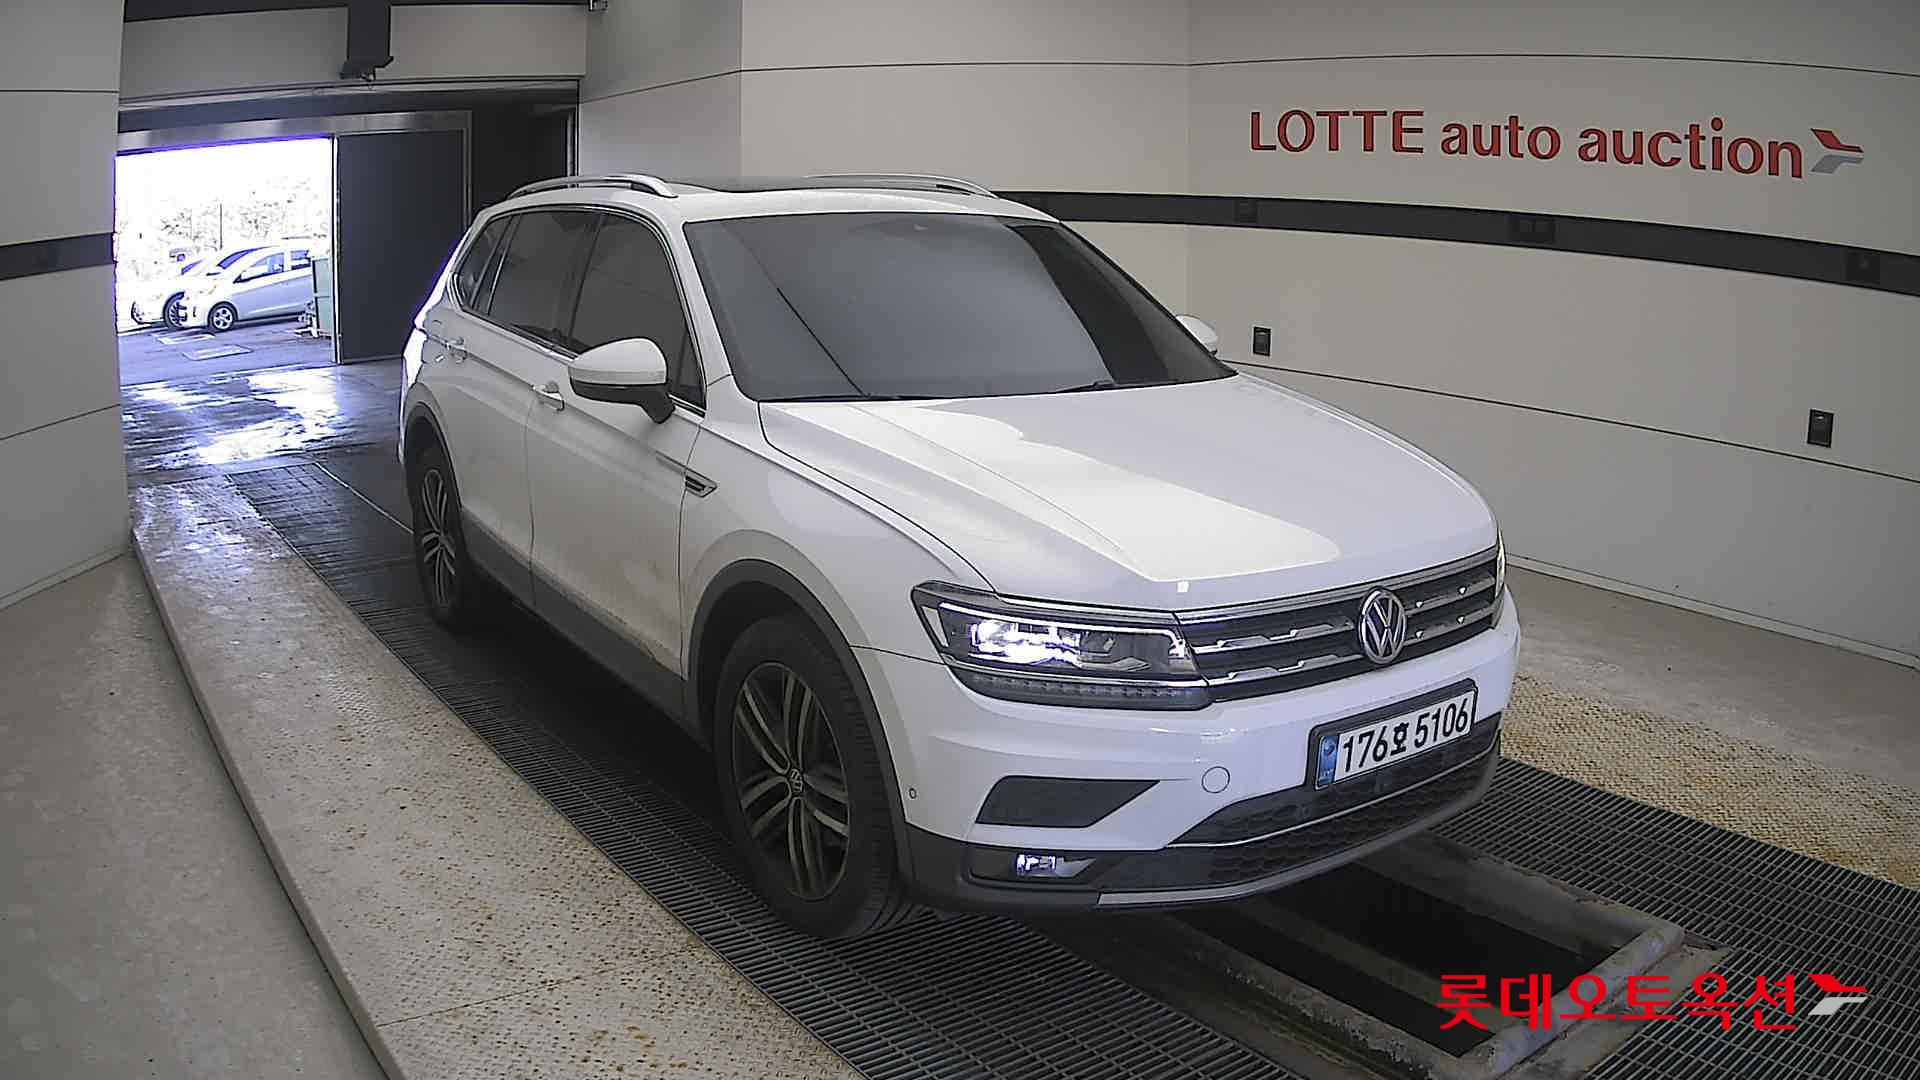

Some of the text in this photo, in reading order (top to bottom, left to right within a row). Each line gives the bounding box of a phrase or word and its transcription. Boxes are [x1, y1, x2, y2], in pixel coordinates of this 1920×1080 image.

[1250, 110, 1804, 179] LOTTE auto auction
